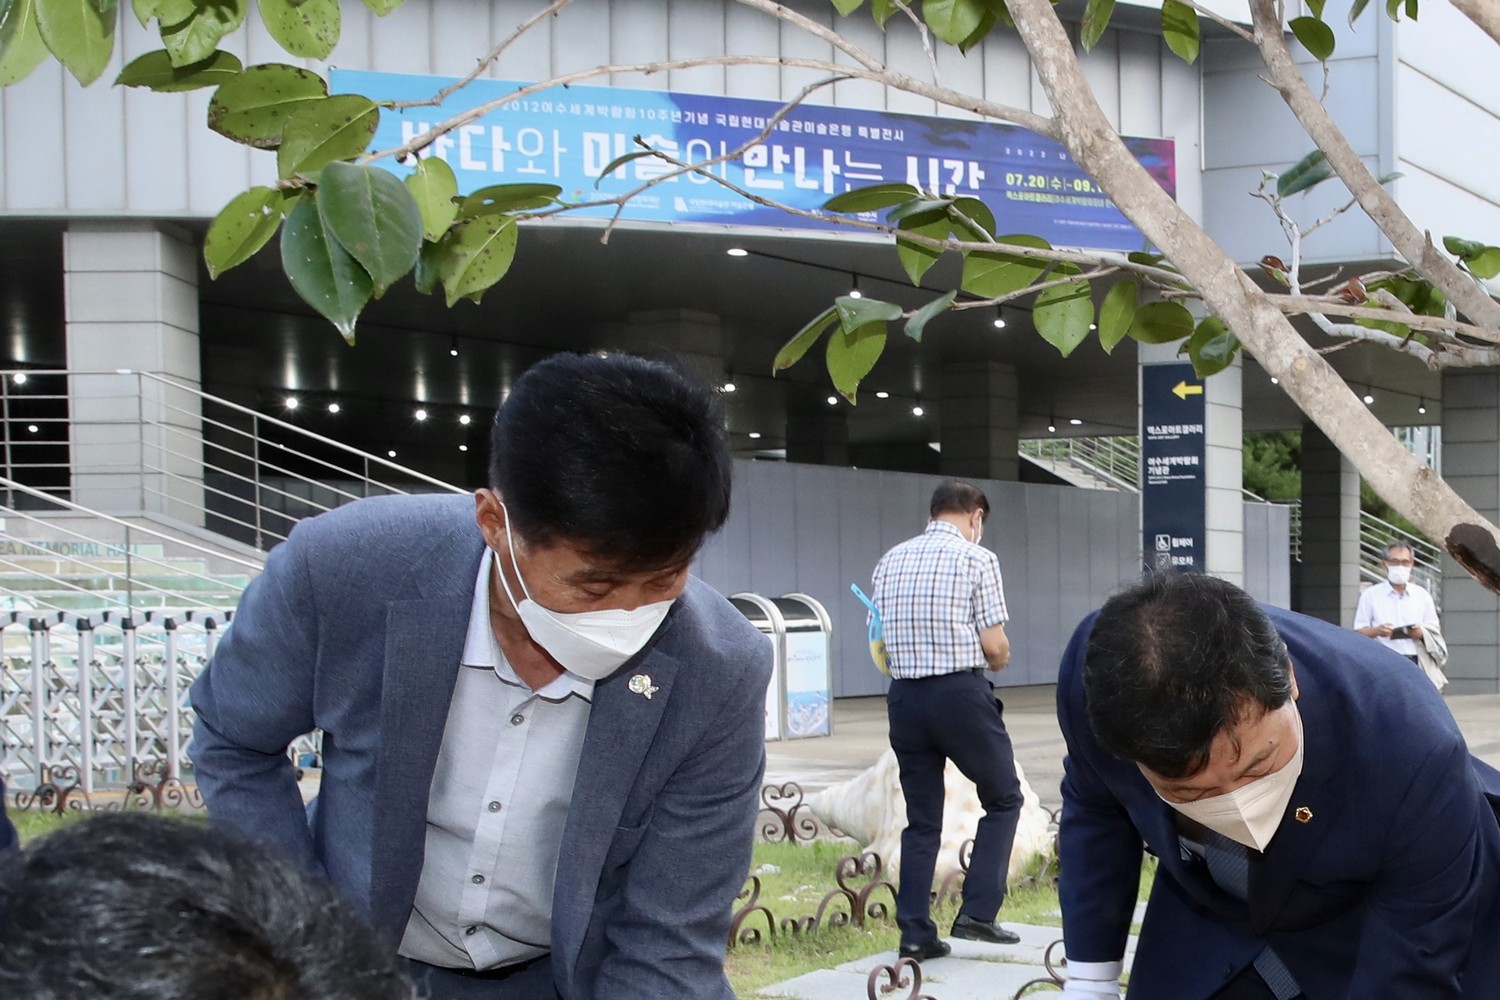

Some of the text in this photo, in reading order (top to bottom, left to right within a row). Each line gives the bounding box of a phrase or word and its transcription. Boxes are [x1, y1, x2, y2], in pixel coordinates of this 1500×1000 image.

[857, 126, 905, 142] 특별전시
[583, 131, 726, 189] 미술이
[906, 155, 986, 201] 시간
[22, 540, 102, 557] MEMORIAL
